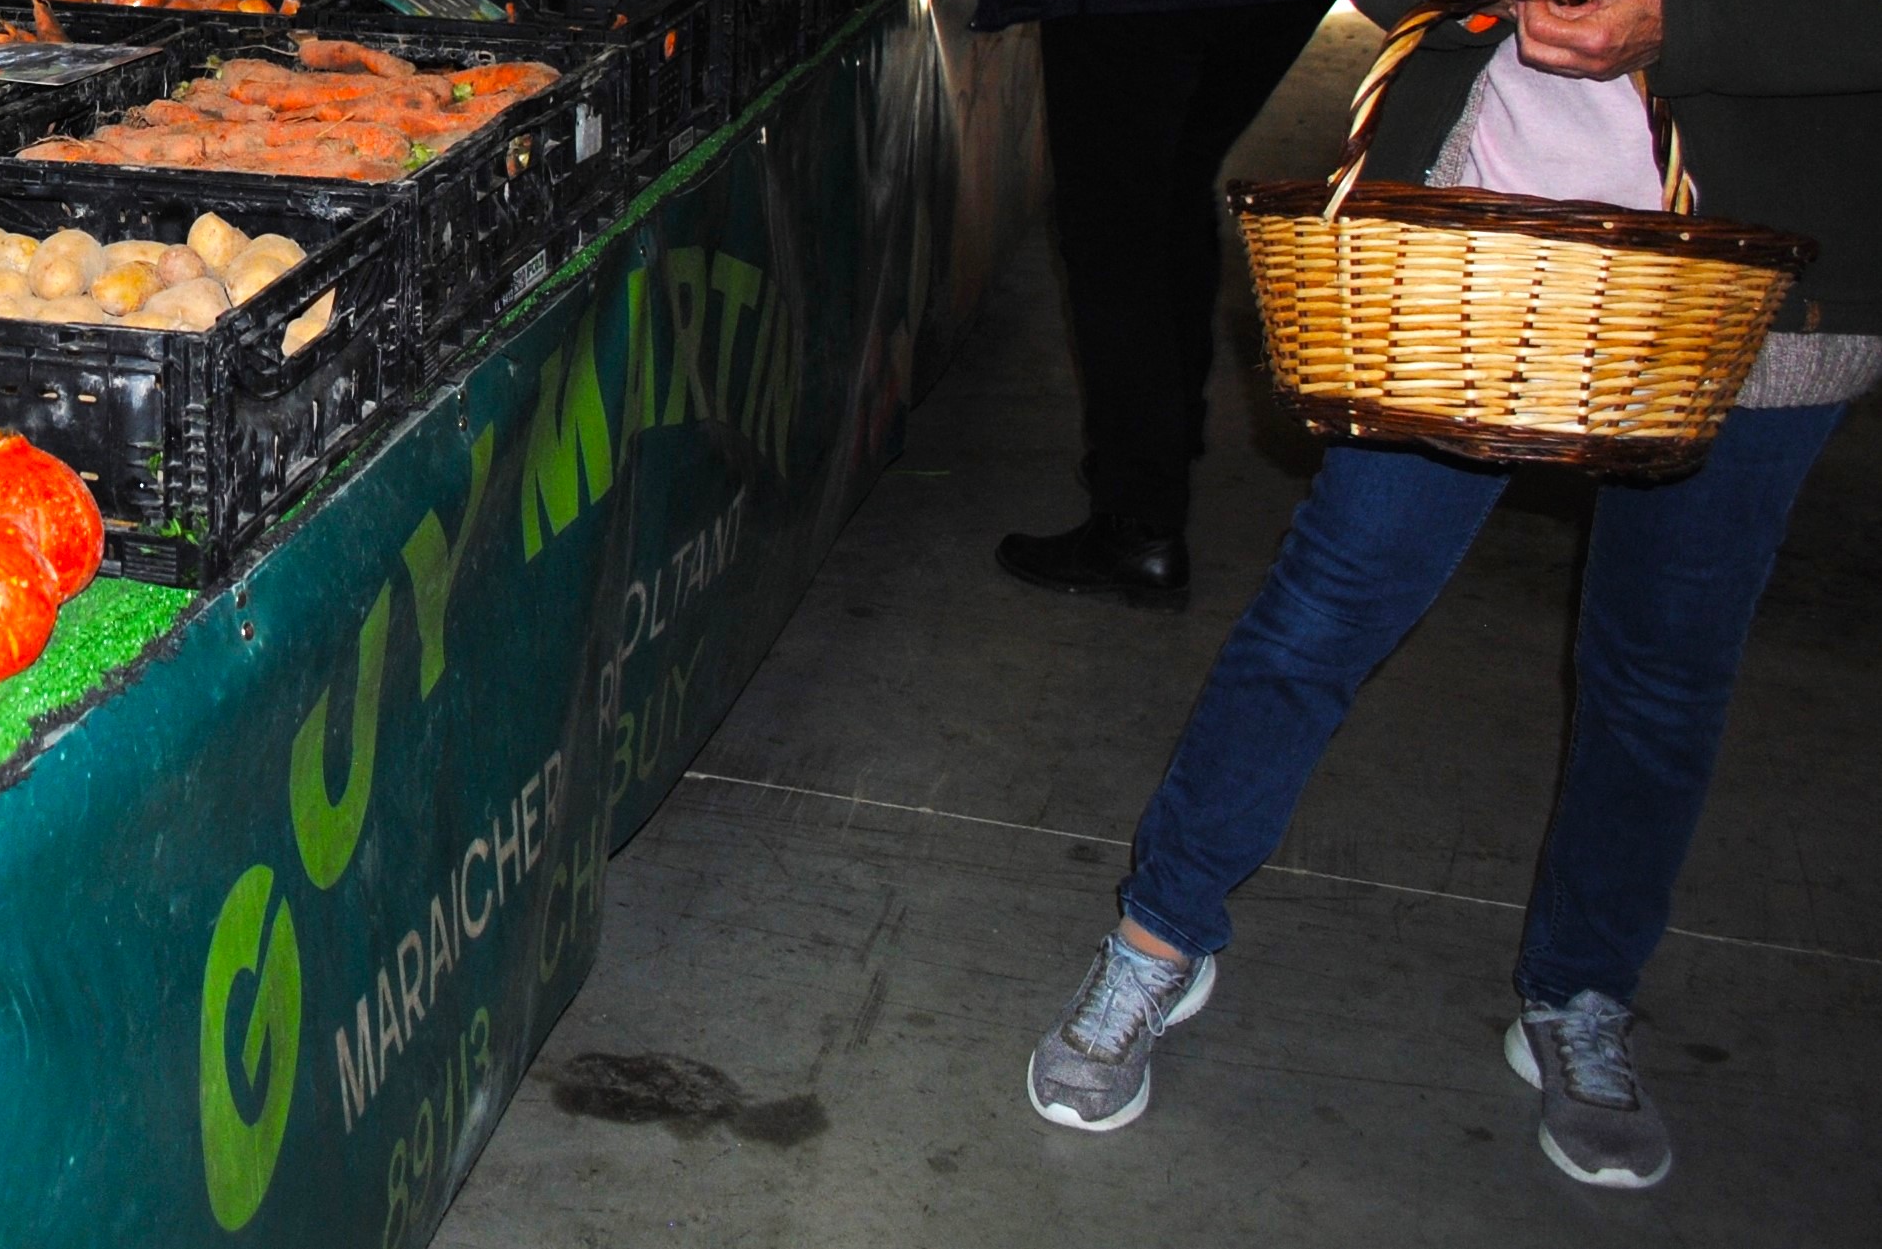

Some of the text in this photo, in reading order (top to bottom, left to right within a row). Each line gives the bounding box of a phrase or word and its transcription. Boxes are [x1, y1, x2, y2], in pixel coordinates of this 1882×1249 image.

[199, 244, 802, 1232] GUY MARTIN
[334, 748, 563, 1132] MARAICHER
